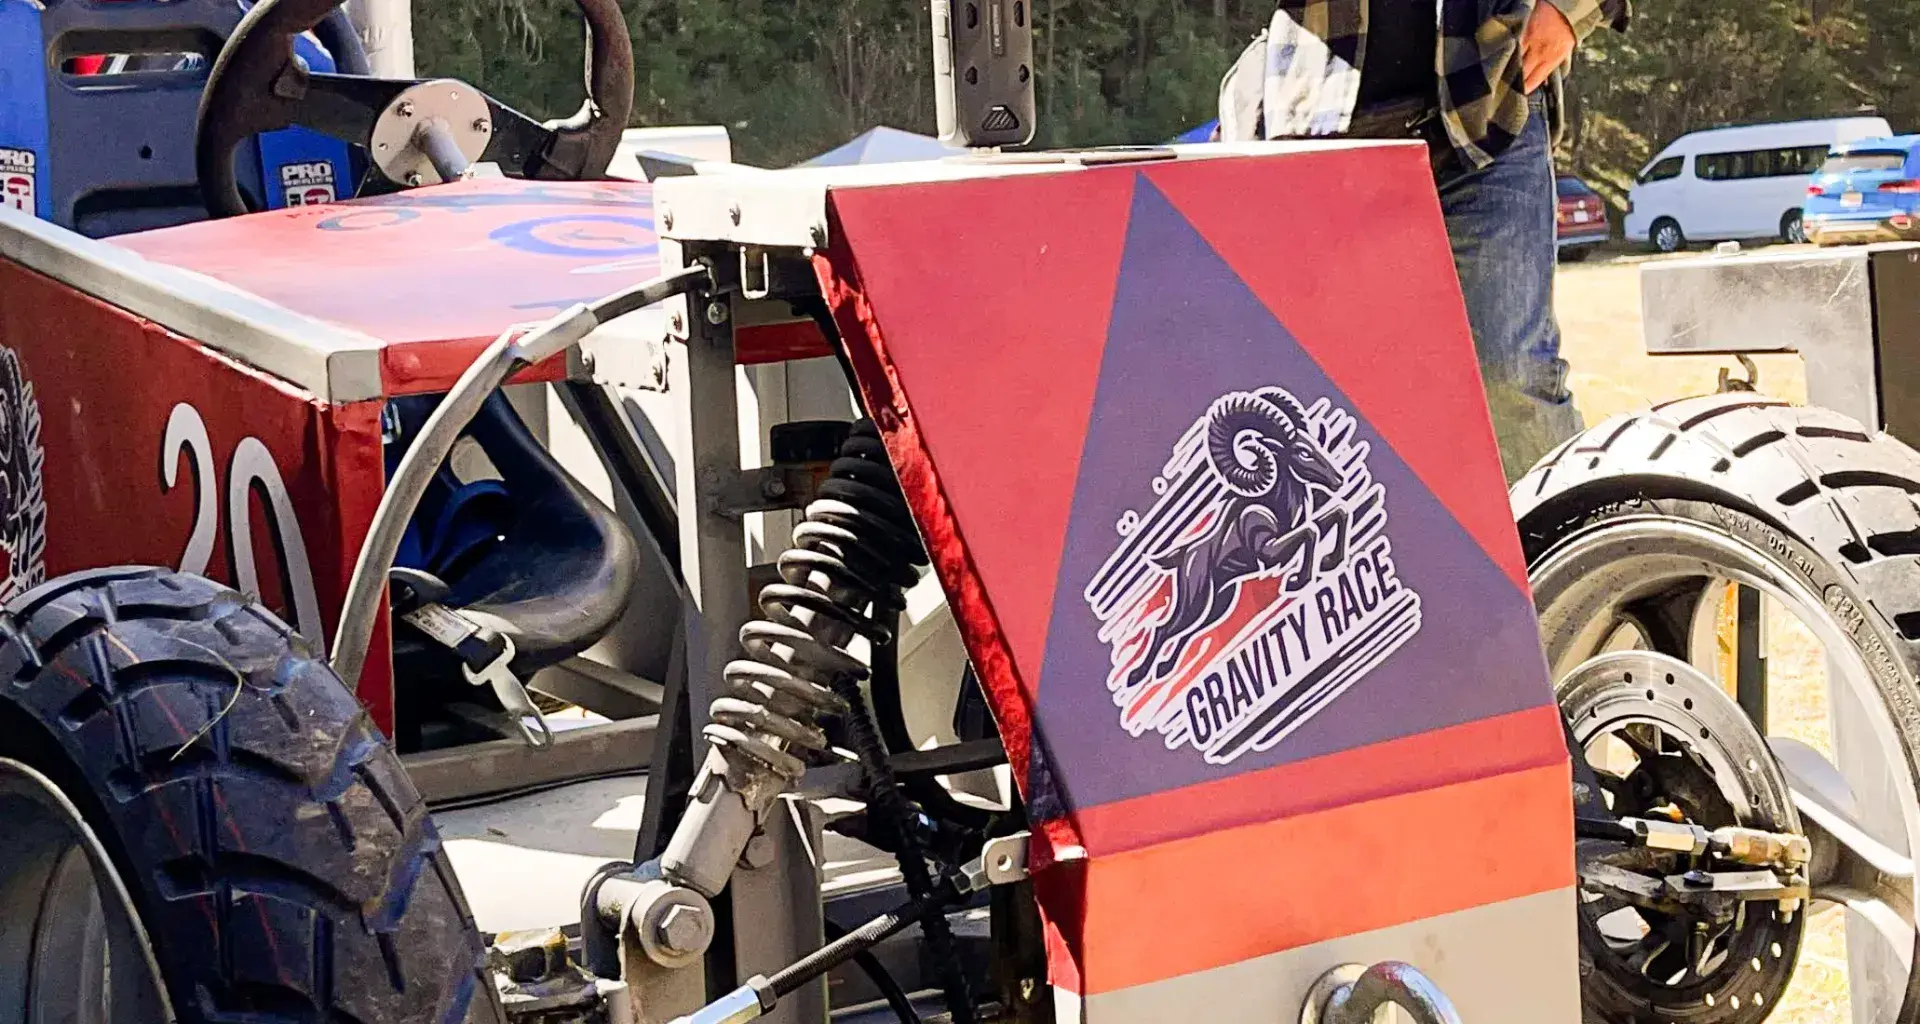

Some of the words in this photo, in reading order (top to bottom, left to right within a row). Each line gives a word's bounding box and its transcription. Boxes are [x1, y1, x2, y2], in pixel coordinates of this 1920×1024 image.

[282, 163, 332, 180] PRO
[162, 402, 325, 659] 20
[1185, 603, 1311, 745] GRAVITY
[1315, 543, 1397, 644] RACE
